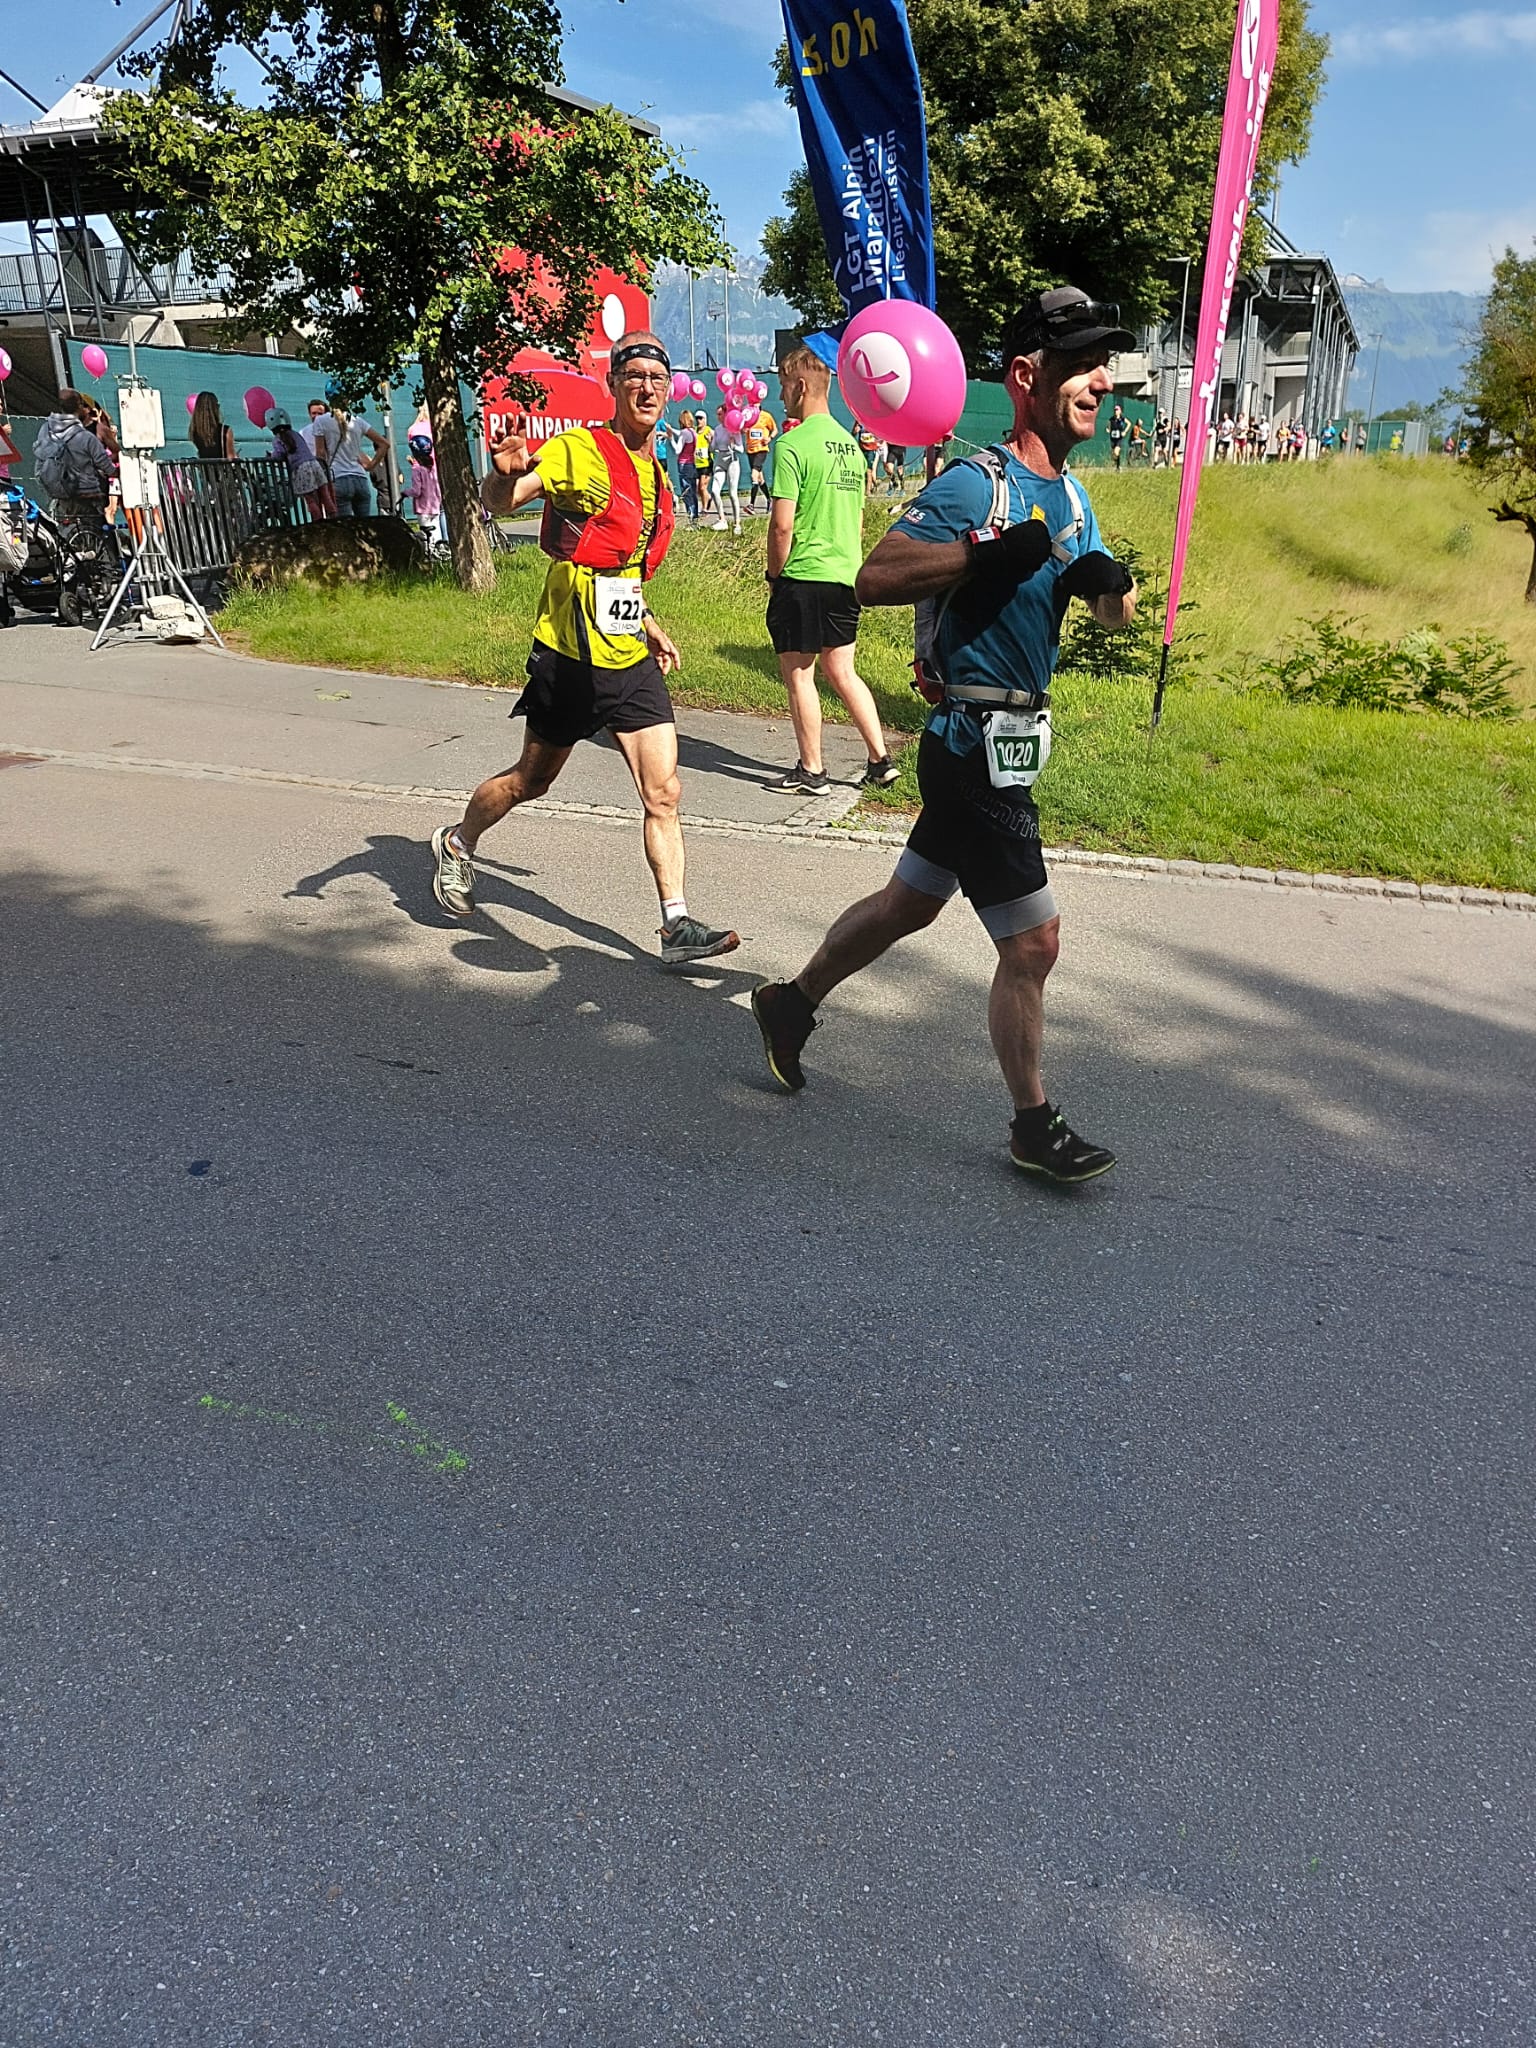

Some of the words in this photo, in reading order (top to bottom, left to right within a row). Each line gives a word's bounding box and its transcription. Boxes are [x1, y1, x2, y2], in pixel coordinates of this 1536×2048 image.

[842, 145, 867, 220] Alpin
[863, 137, 885, 288] Marathon
[844, 231, 865, 293] LGT
[825, 441, 857, 456] STAFF
[608, 599, 640, 620] 422
[997, 741, 1034, 767] 1020
